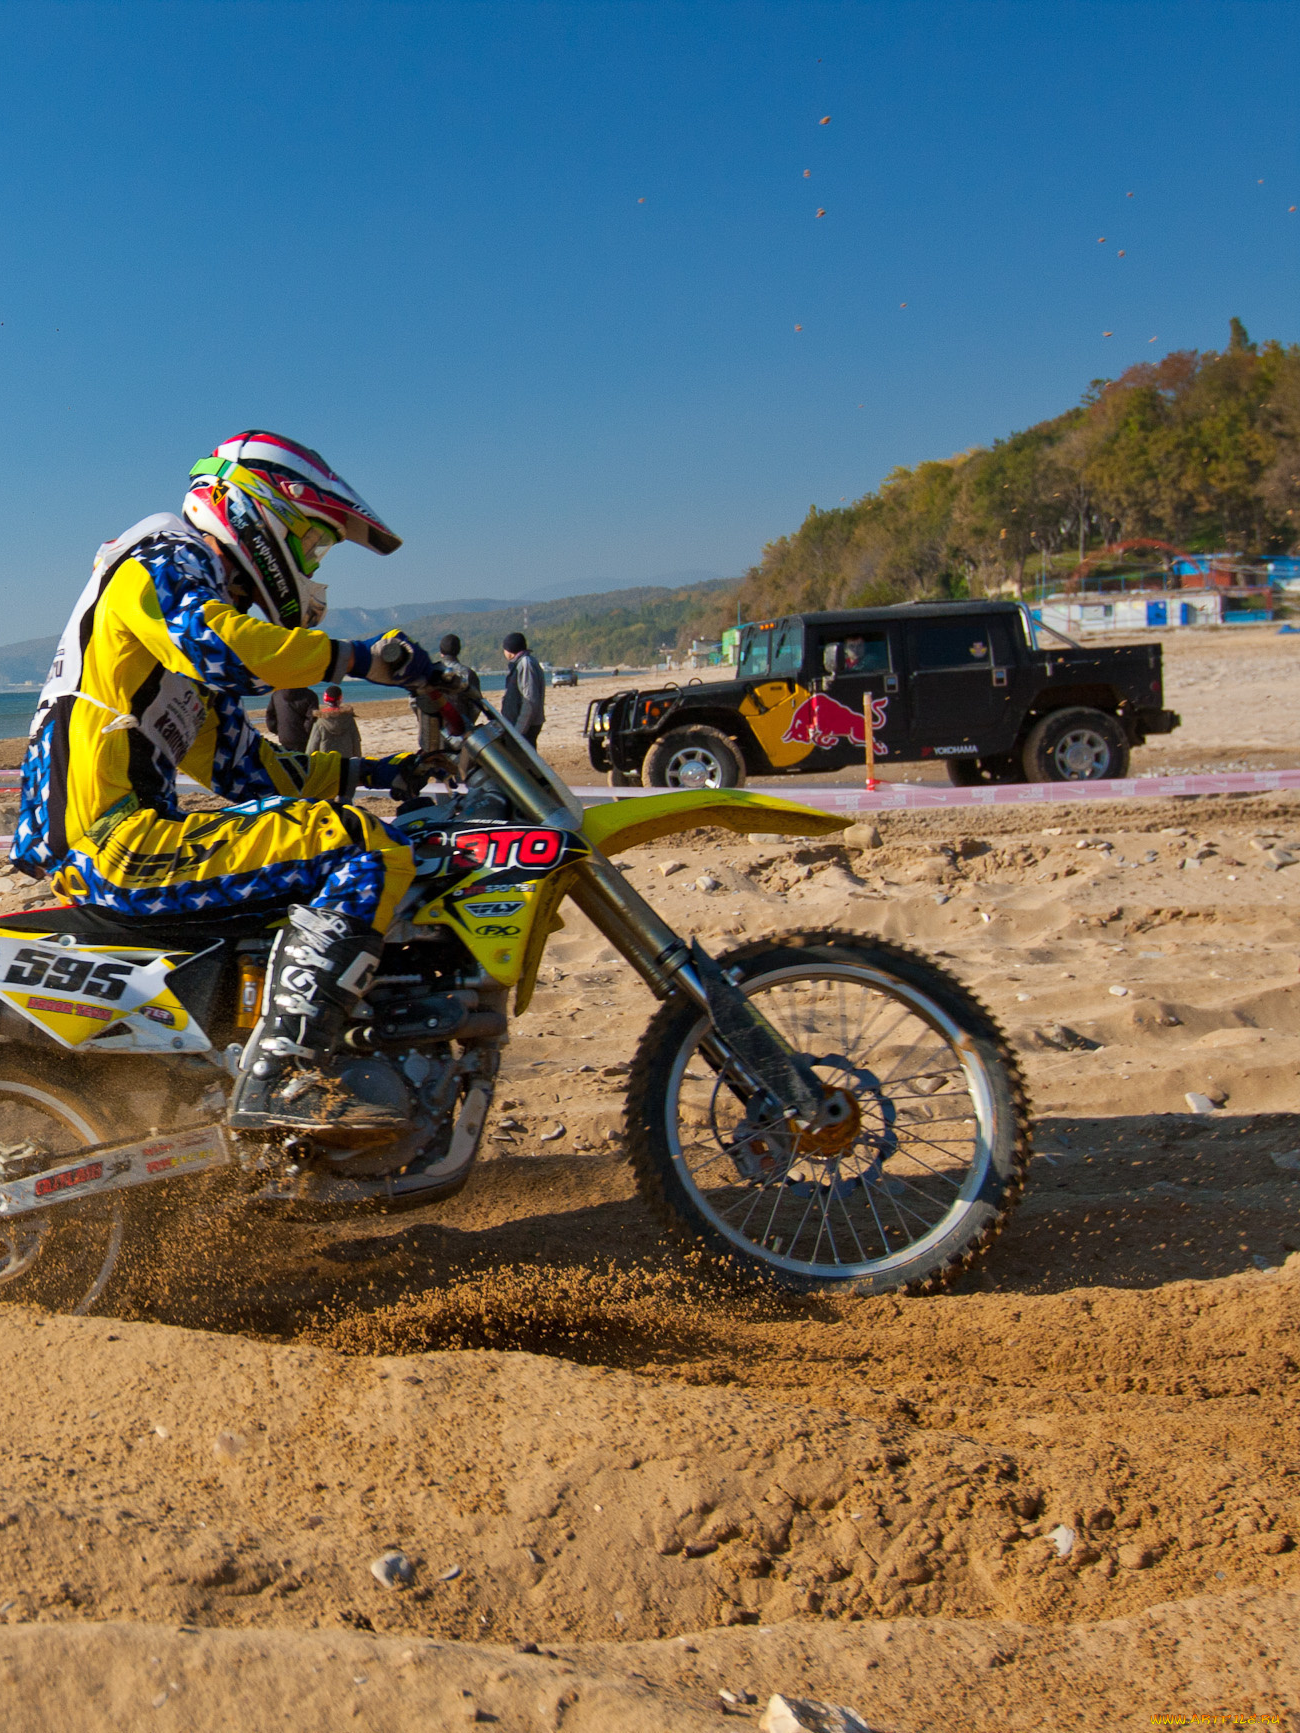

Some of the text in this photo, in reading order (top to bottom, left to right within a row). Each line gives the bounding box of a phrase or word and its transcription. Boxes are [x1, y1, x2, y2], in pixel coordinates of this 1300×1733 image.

[252, 534, 290, 599] MONSTER
[933, 744, 979, 755] YOKOHAMA
[465, 902, 524, 915] FLY
[3, 948, 134, 1001] 595
[75, 1004, 114, 1021] TEAM
